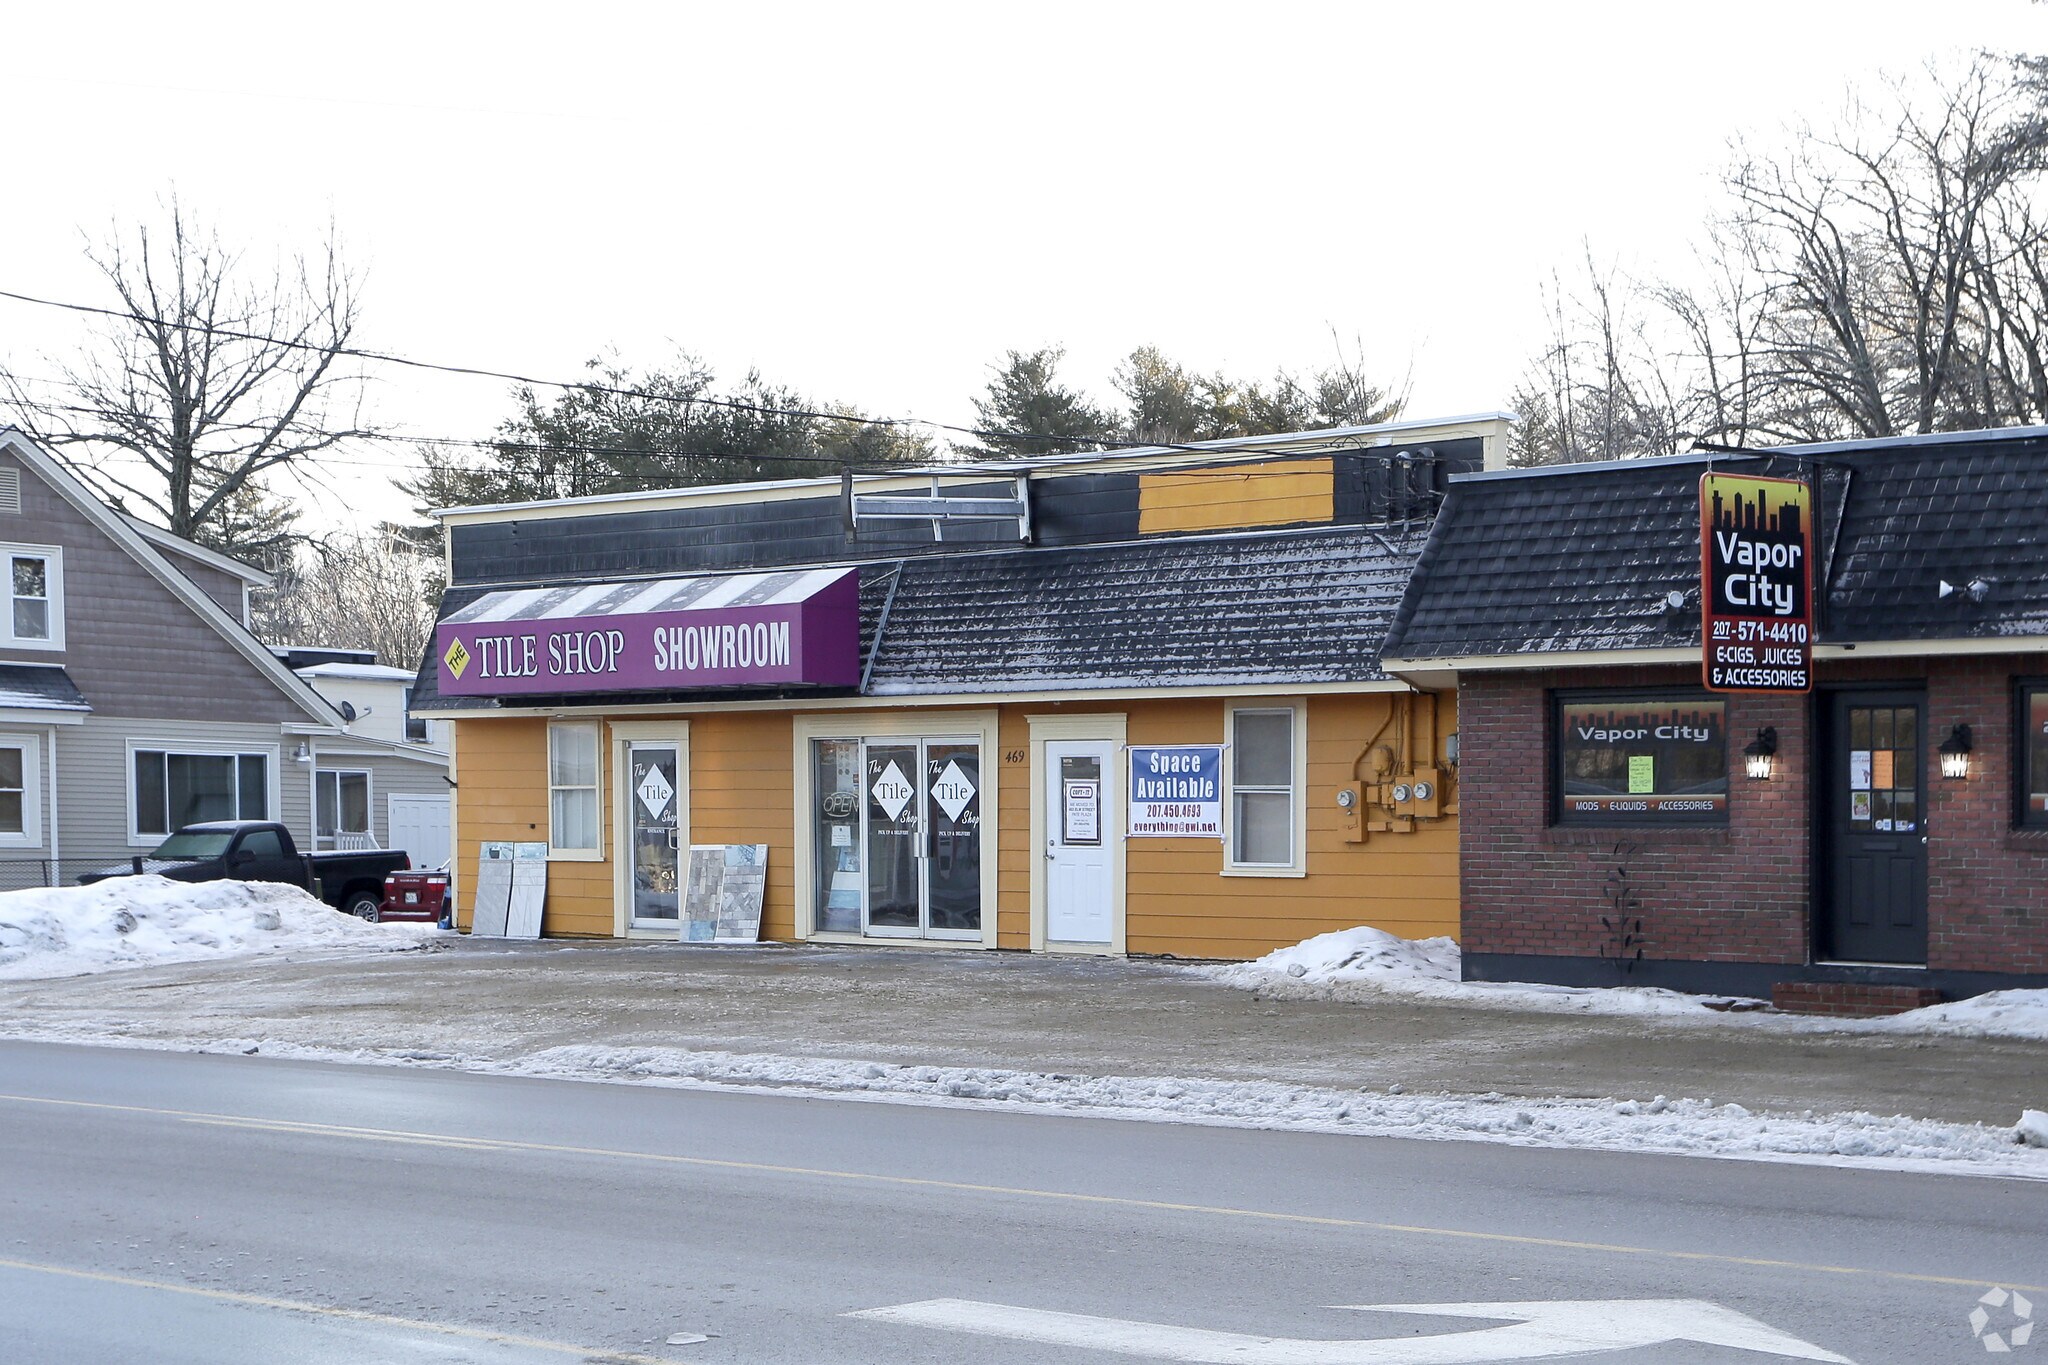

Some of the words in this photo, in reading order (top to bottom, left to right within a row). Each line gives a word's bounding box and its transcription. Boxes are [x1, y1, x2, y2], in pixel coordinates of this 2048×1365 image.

[1716, 531, 1801, 574] Vapor
[1724, 573, 1793, 615] City
[1712, 620, 1807, 643] 207-571-4410
[475, 635, 539, 678] TILE
[547, 630, 625, 676] SHOP
[653, 621, 791, 672] SHOWROOM
[448, 644, 466, 671] THE
[1716, 645, 1757, 667] E-CIGS,
[1761, 648, 1802, 666] JUICES
[1712, 667, 1723, 685] &
[1724, 668, 1806, 687] ACCESSORIES
[1577, 726, 1648, 743] Vapor
[1654, 726, 1709, 742] City
[1005, 750, 1025, 764] 469
[1150, 752, 1201, 775] Space
[634, 762, 646, 777] The
[868, 759, 882, 775] The
[928, 759, 943, 775] The
[643, 785, 668, 800] Tile
[878, 782, 908, 799] Tile
[937, 782, 968, 800] Tile
[1137, 777, 1214, 798] Available
[823, 796, 859, 812] OPEN
[1575, 801, 1599, 811] MODS
[1609, 801, 1647, 811] E-LIQUIDS
[1658, 800, 1713, 811] ACCESSORIES
[661, 809, 677, 826] Shop
[900, 809, 918, 828] Shop
[961, 809, 980, 829] Shop
[1134, 821, 1217, 832] everything@gwi.net
